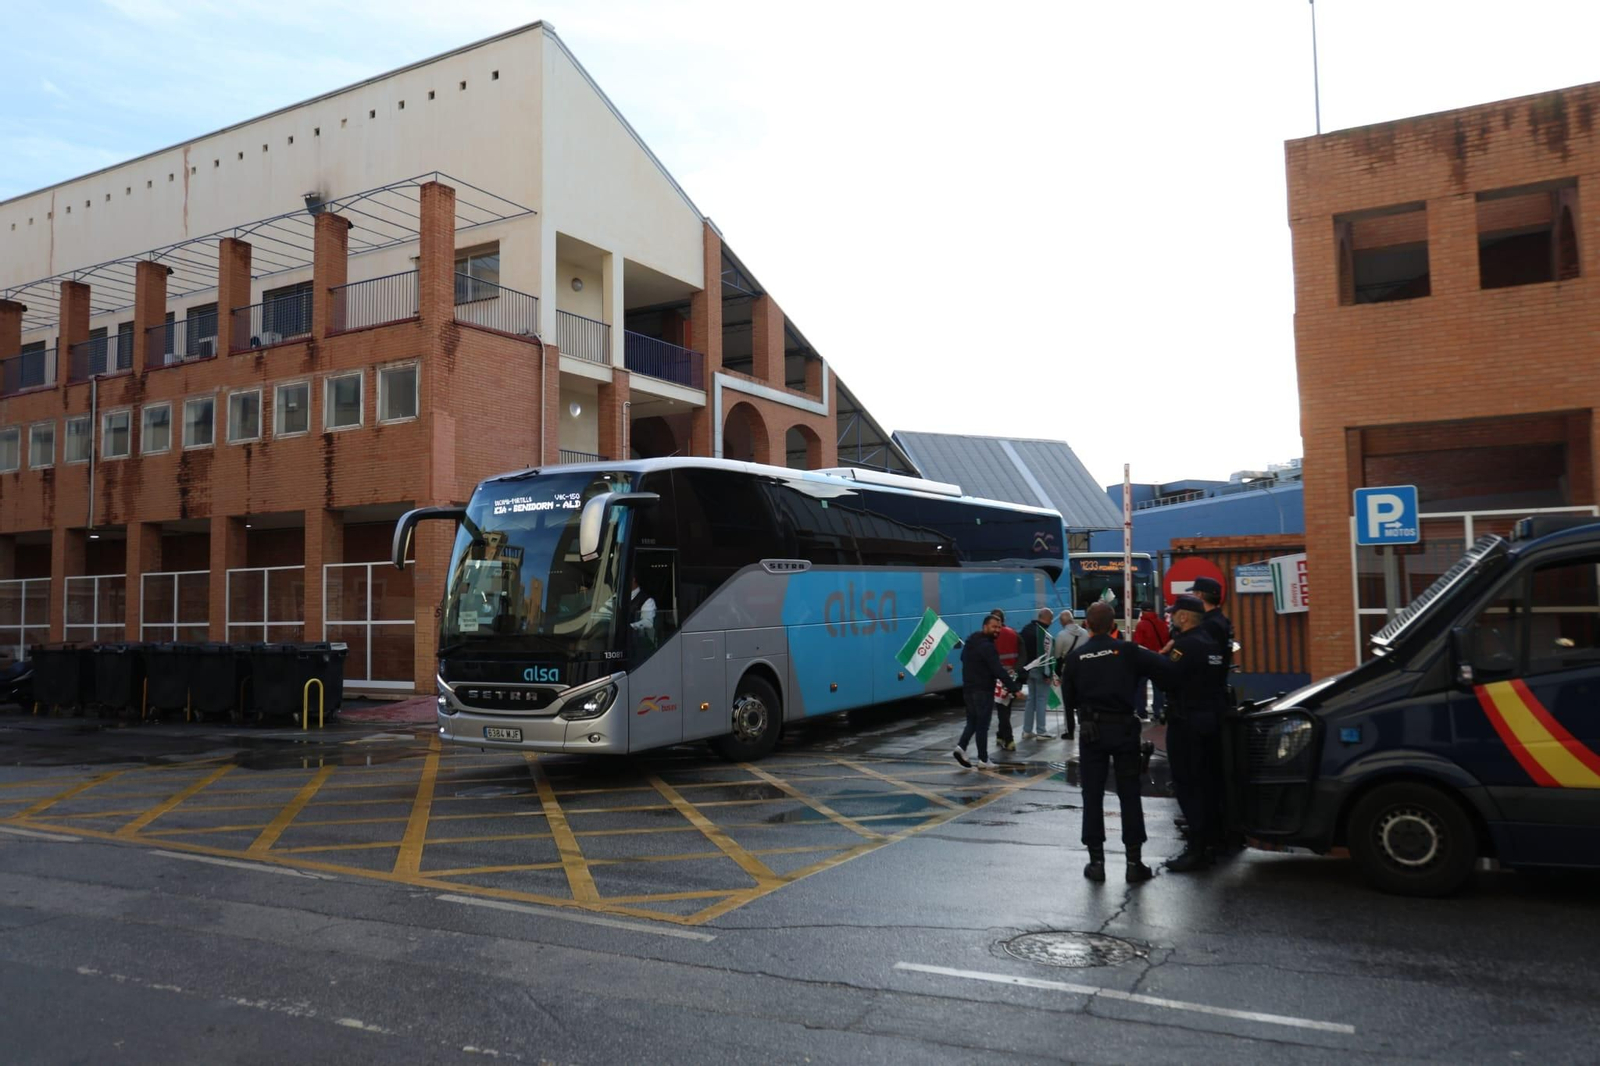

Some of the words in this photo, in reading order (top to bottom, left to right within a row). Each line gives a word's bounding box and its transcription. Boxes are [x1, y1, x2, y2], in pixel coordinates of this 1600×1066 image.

[513, 501, 554, 512] BENIDORM
[1366, 494, 1404, 538] P
[1385, 528, 1416, 537] MOTOS
[824, 581, 897, 638] alsa
[523, 665, 559, 682] alsa
[468, 690, 538, 701] SETRA
